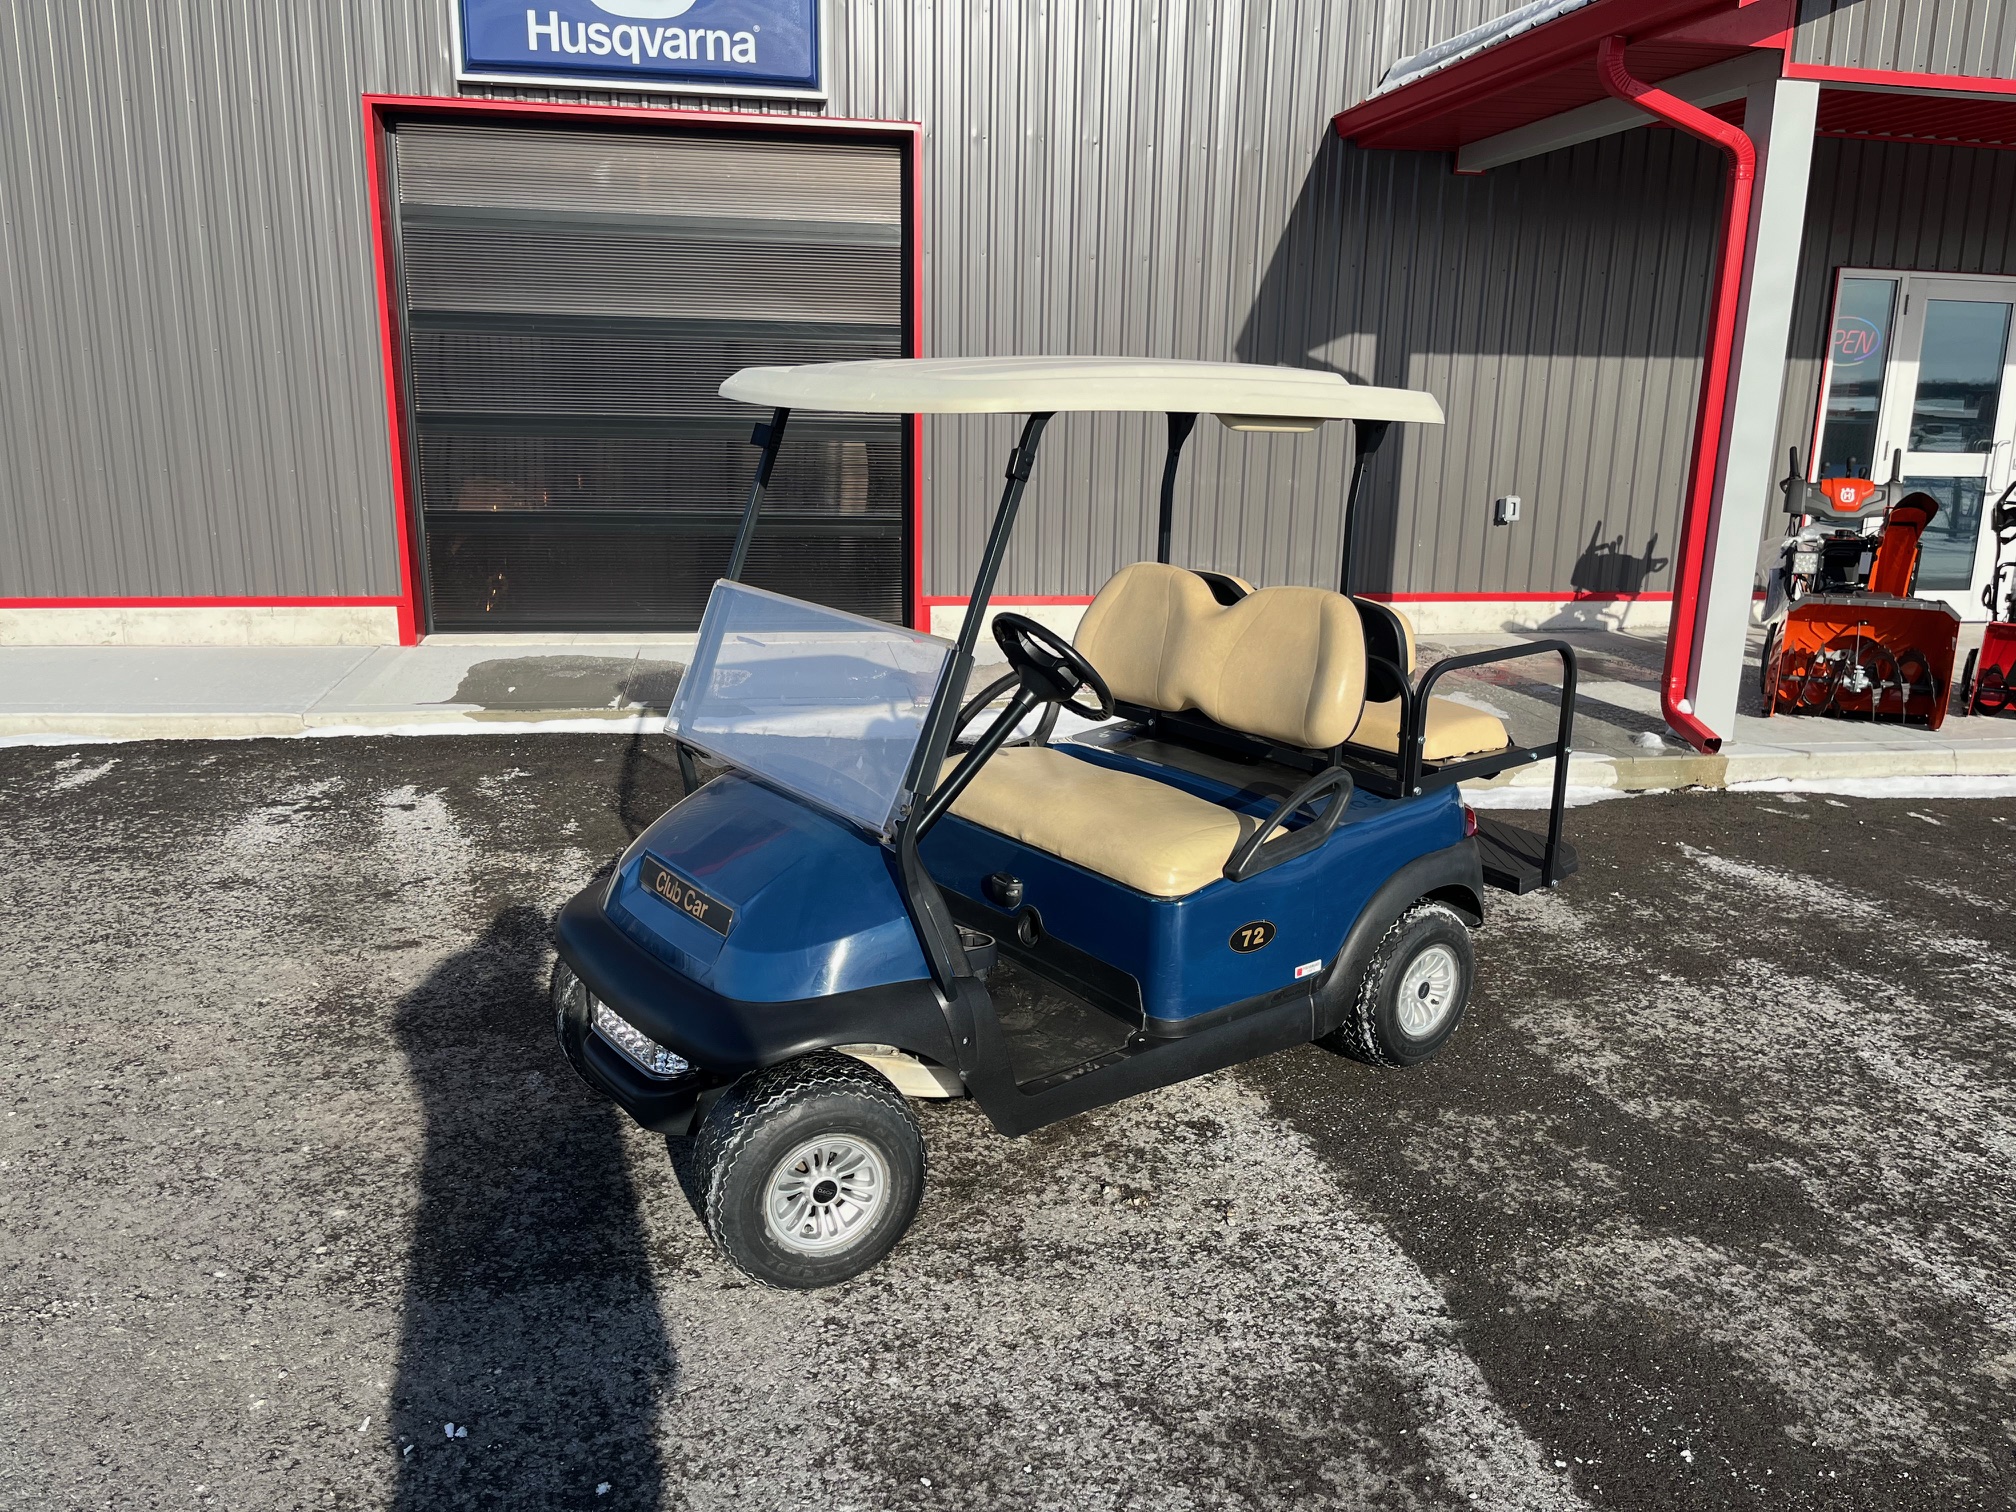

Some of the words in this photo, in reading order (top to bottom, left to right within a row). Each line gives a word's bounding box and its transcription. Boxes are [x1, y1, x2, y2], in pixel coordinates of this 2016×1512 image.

[526, 9, 757, 65] Husqvarna
[1834, 329, 1876, 354] PEN
[655, 871, 682, 904] Club
[683, 889, 709, 919] Car
[1241, 926, 1265, 948] 72
